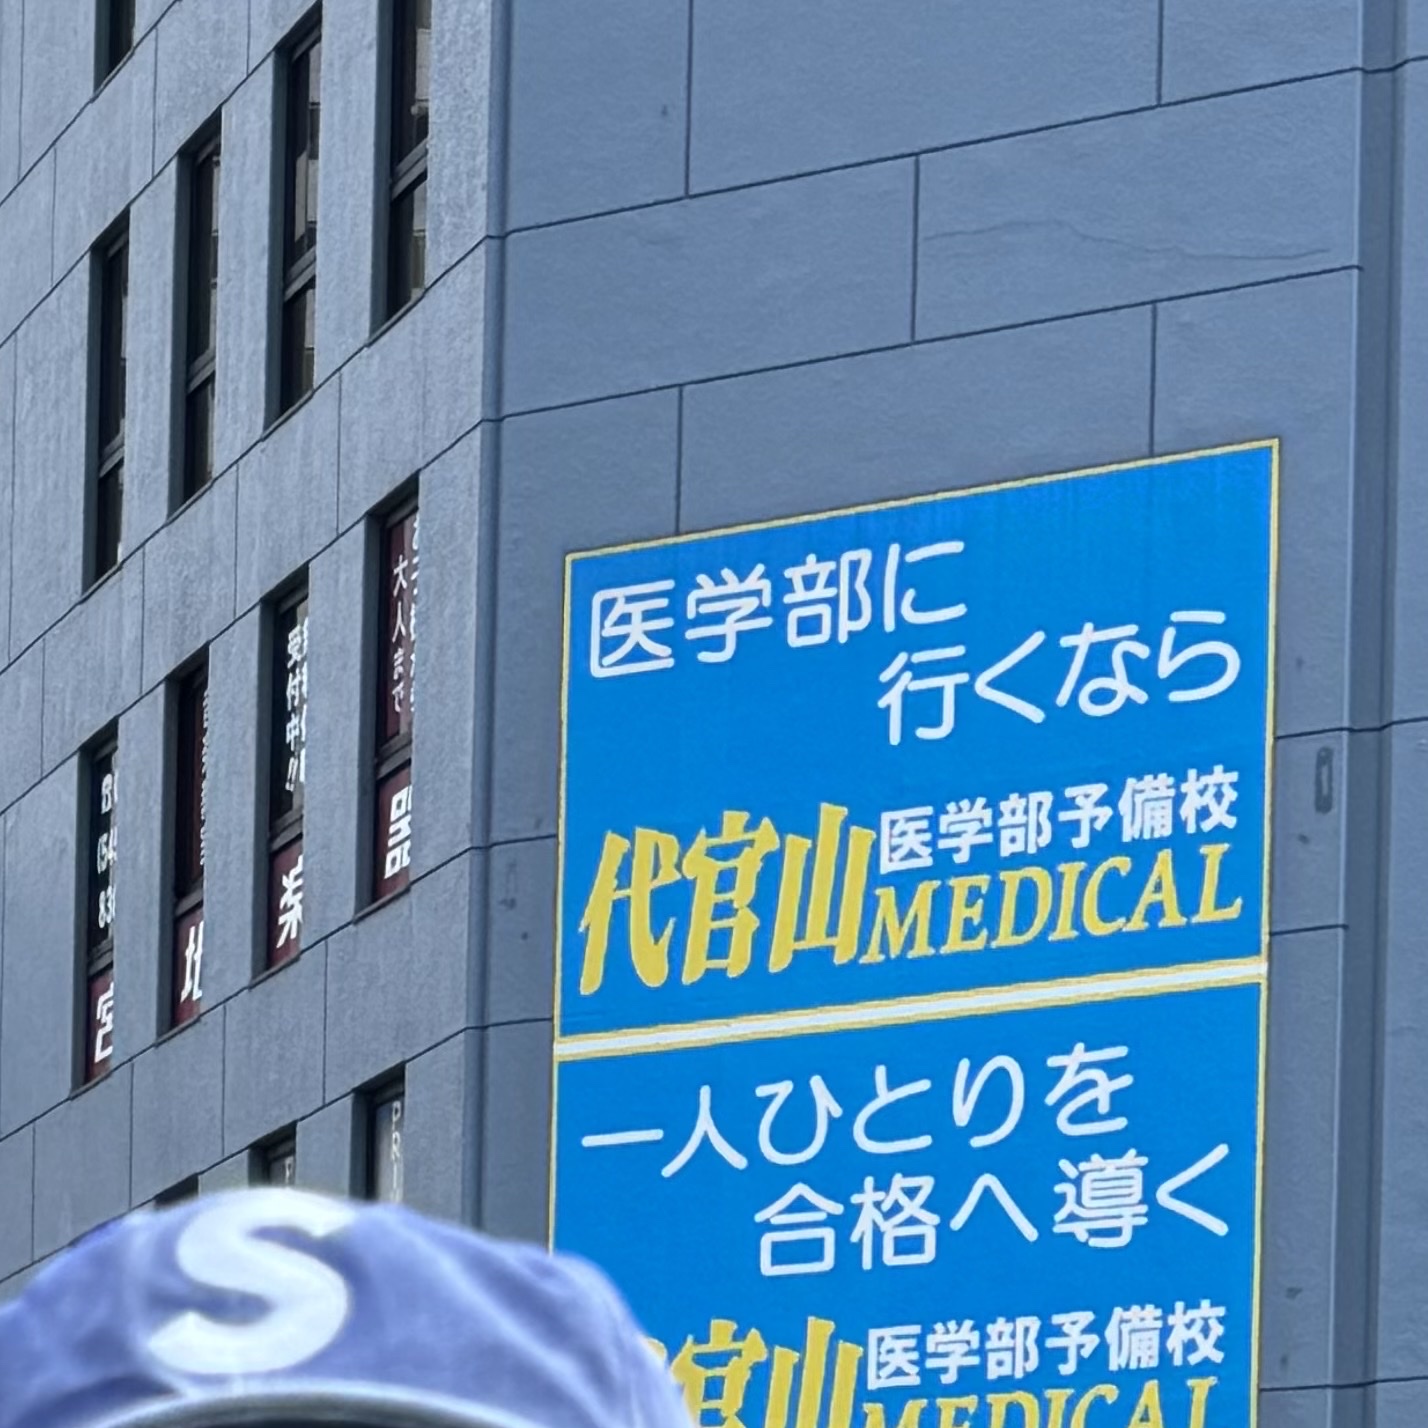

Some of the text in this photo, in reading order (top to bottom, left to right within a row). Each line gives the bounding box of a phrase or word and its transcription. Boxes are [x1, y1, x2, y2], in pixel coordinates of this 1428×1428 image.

[590, 541, 967, 679] 医学部に
[877, 611, 1242, 746] 行くなら
[878, 765, 1240, 875] 医学部予備校
[579, 803, 876, 995] 代官山
[860, 843, 1245, 965] MEDICAL
[581, 1042, 1135, 1178] 一人ひとりを
[754, 1143, 1230, 1277] 合格へ導く
[147, 1187, 356, 1375] S
[867, 1299, 1227, 1390] 医学部予備校
